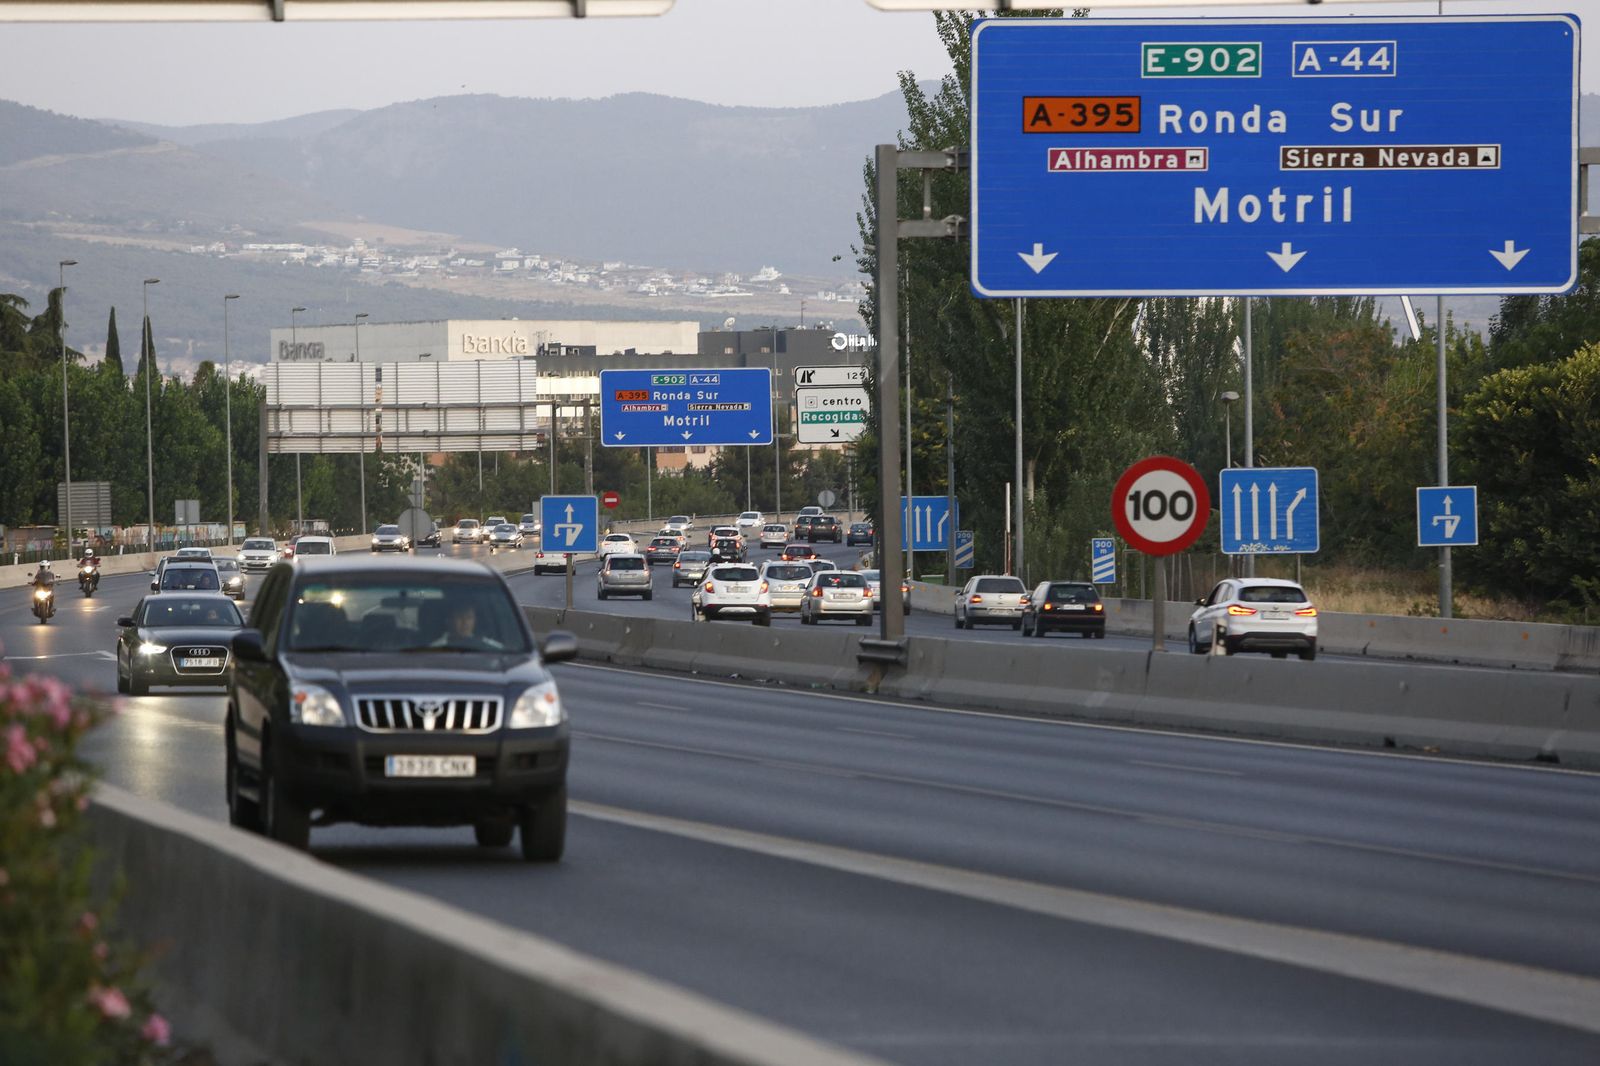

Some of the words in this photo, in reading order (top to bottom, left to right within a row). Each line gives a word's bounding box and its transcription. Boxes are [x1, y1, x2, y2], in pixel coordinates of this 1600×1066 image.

[1146, 47, 1256, 72] E-902
[1299, 47, 1391, 71] A-44
[1030, 104, 1134, 126] A-395
[1159, 105, 1287, 133] Ronda
[1330, 103, 1403, 132] Sur
[1055, 151, 1178, 169] Alhambra
[1286, 149, 1364, 167] Sierra
[1378, 149, 1470, 167] Nevada
[1194, 187, 1352, 223] Motril
[279, 340, 325, 360] Bankia
[463, 333, 527, 354] Bankia
[653, 376, 685, 384] E-902
[691, 376, 719, 384] A-44
[617, 392, 648, 400] A-395
[653, 391, 691, 401] Ronda
[696, 390, 719, 400] Sur
[822, 397, 862, 406] centro
[663, 415, 710, 426] Motril
[1129, 489, 1194, 521] 100
